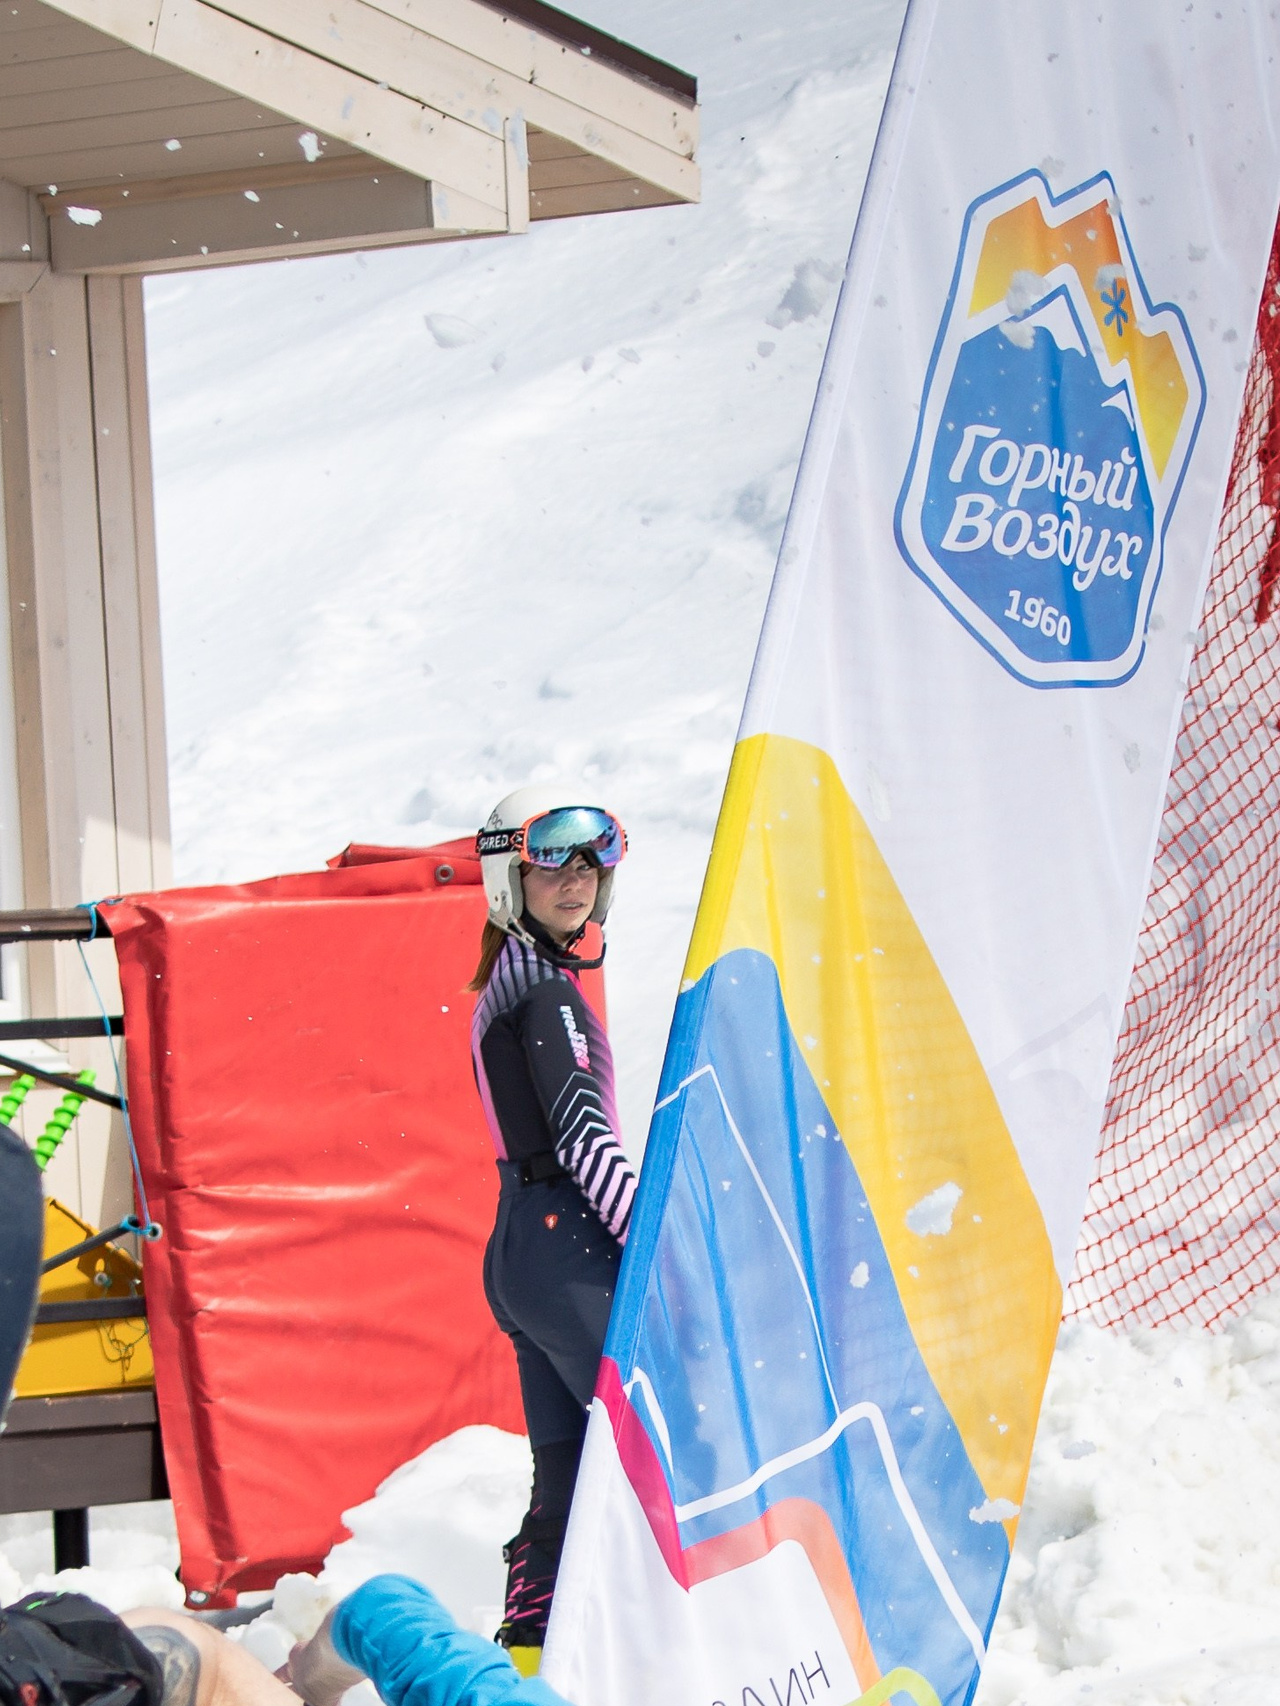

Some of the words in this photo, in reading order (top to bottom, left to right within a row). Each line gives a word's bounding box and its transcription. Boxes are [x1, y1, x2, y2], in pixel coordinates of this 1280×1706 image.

[949, 424, 1138, 511] Горный
[940, 493, 1143, 591] Воздух
[1004, 589, 1072, 645] 1960
